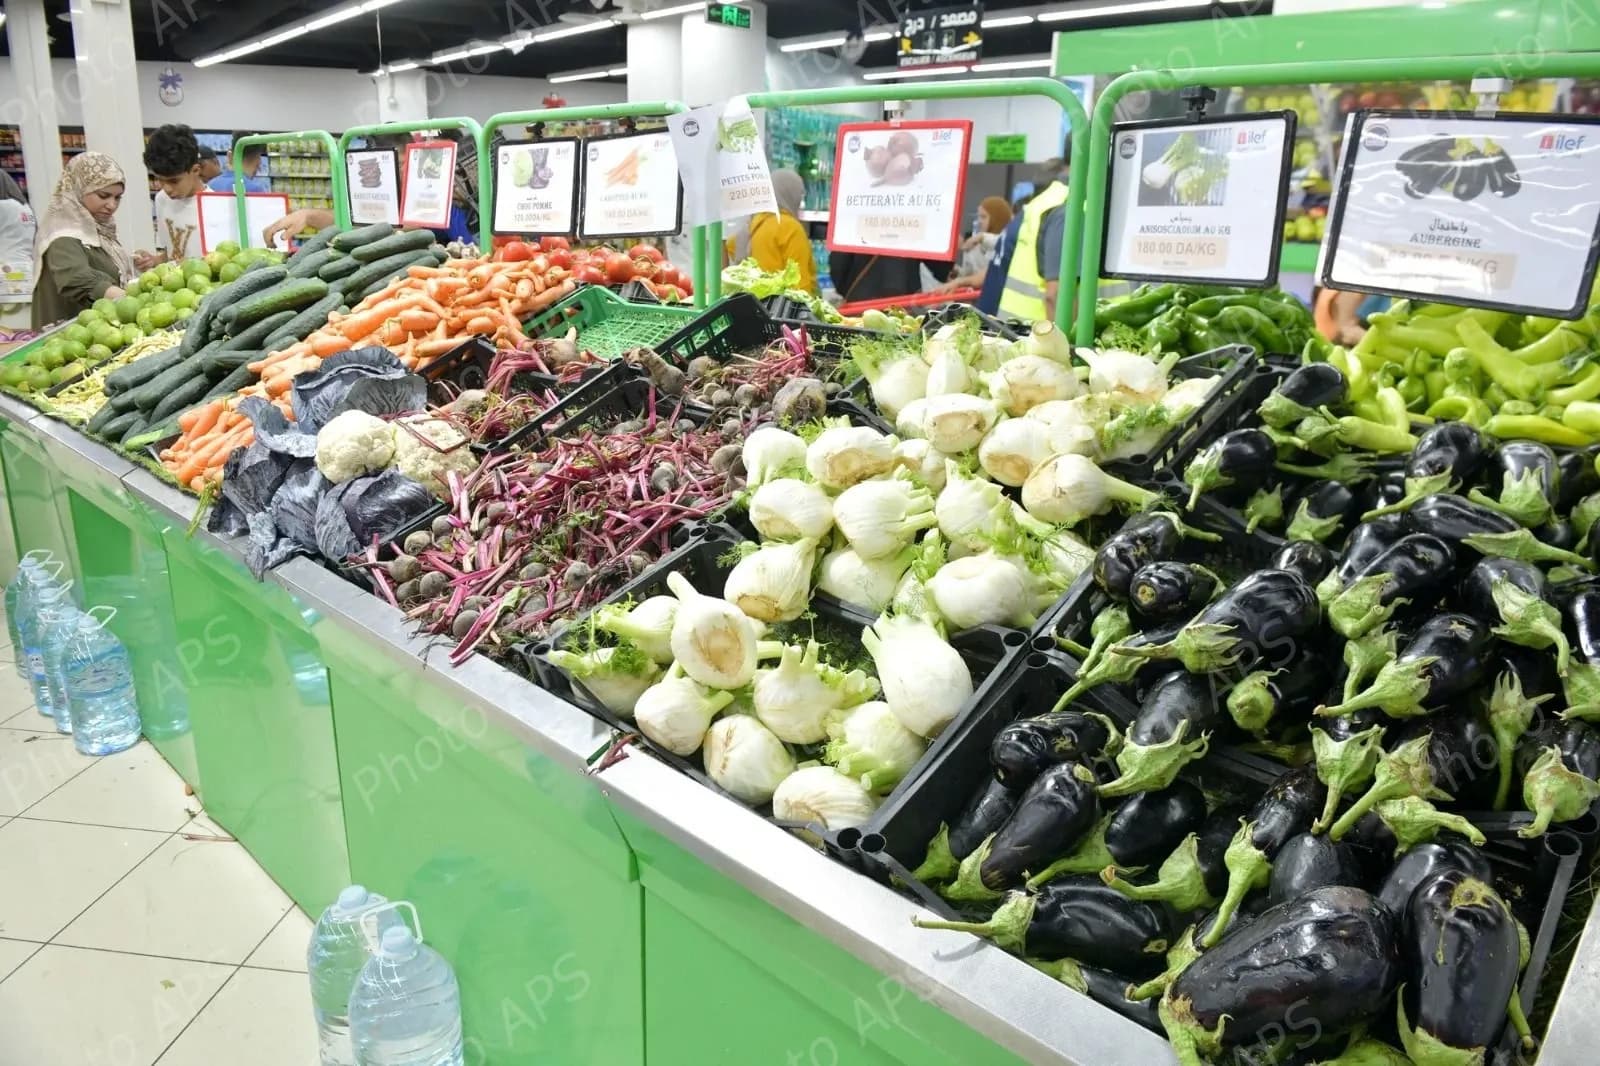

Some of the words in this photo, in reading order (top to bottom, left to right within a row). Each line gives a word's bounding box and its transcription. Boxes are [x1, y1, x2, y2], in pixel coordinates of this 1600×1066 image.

[846, 193, 905, 207] BETTERAVE
[907, 194, 923, 207] AU
[925, 193, 942, 207] KG
[1408, 232, 1483, 249] AUBERGINE
[1137, 241, 1173, 254] 180.00
[1175, 242, 1217, 256] DA/KG
